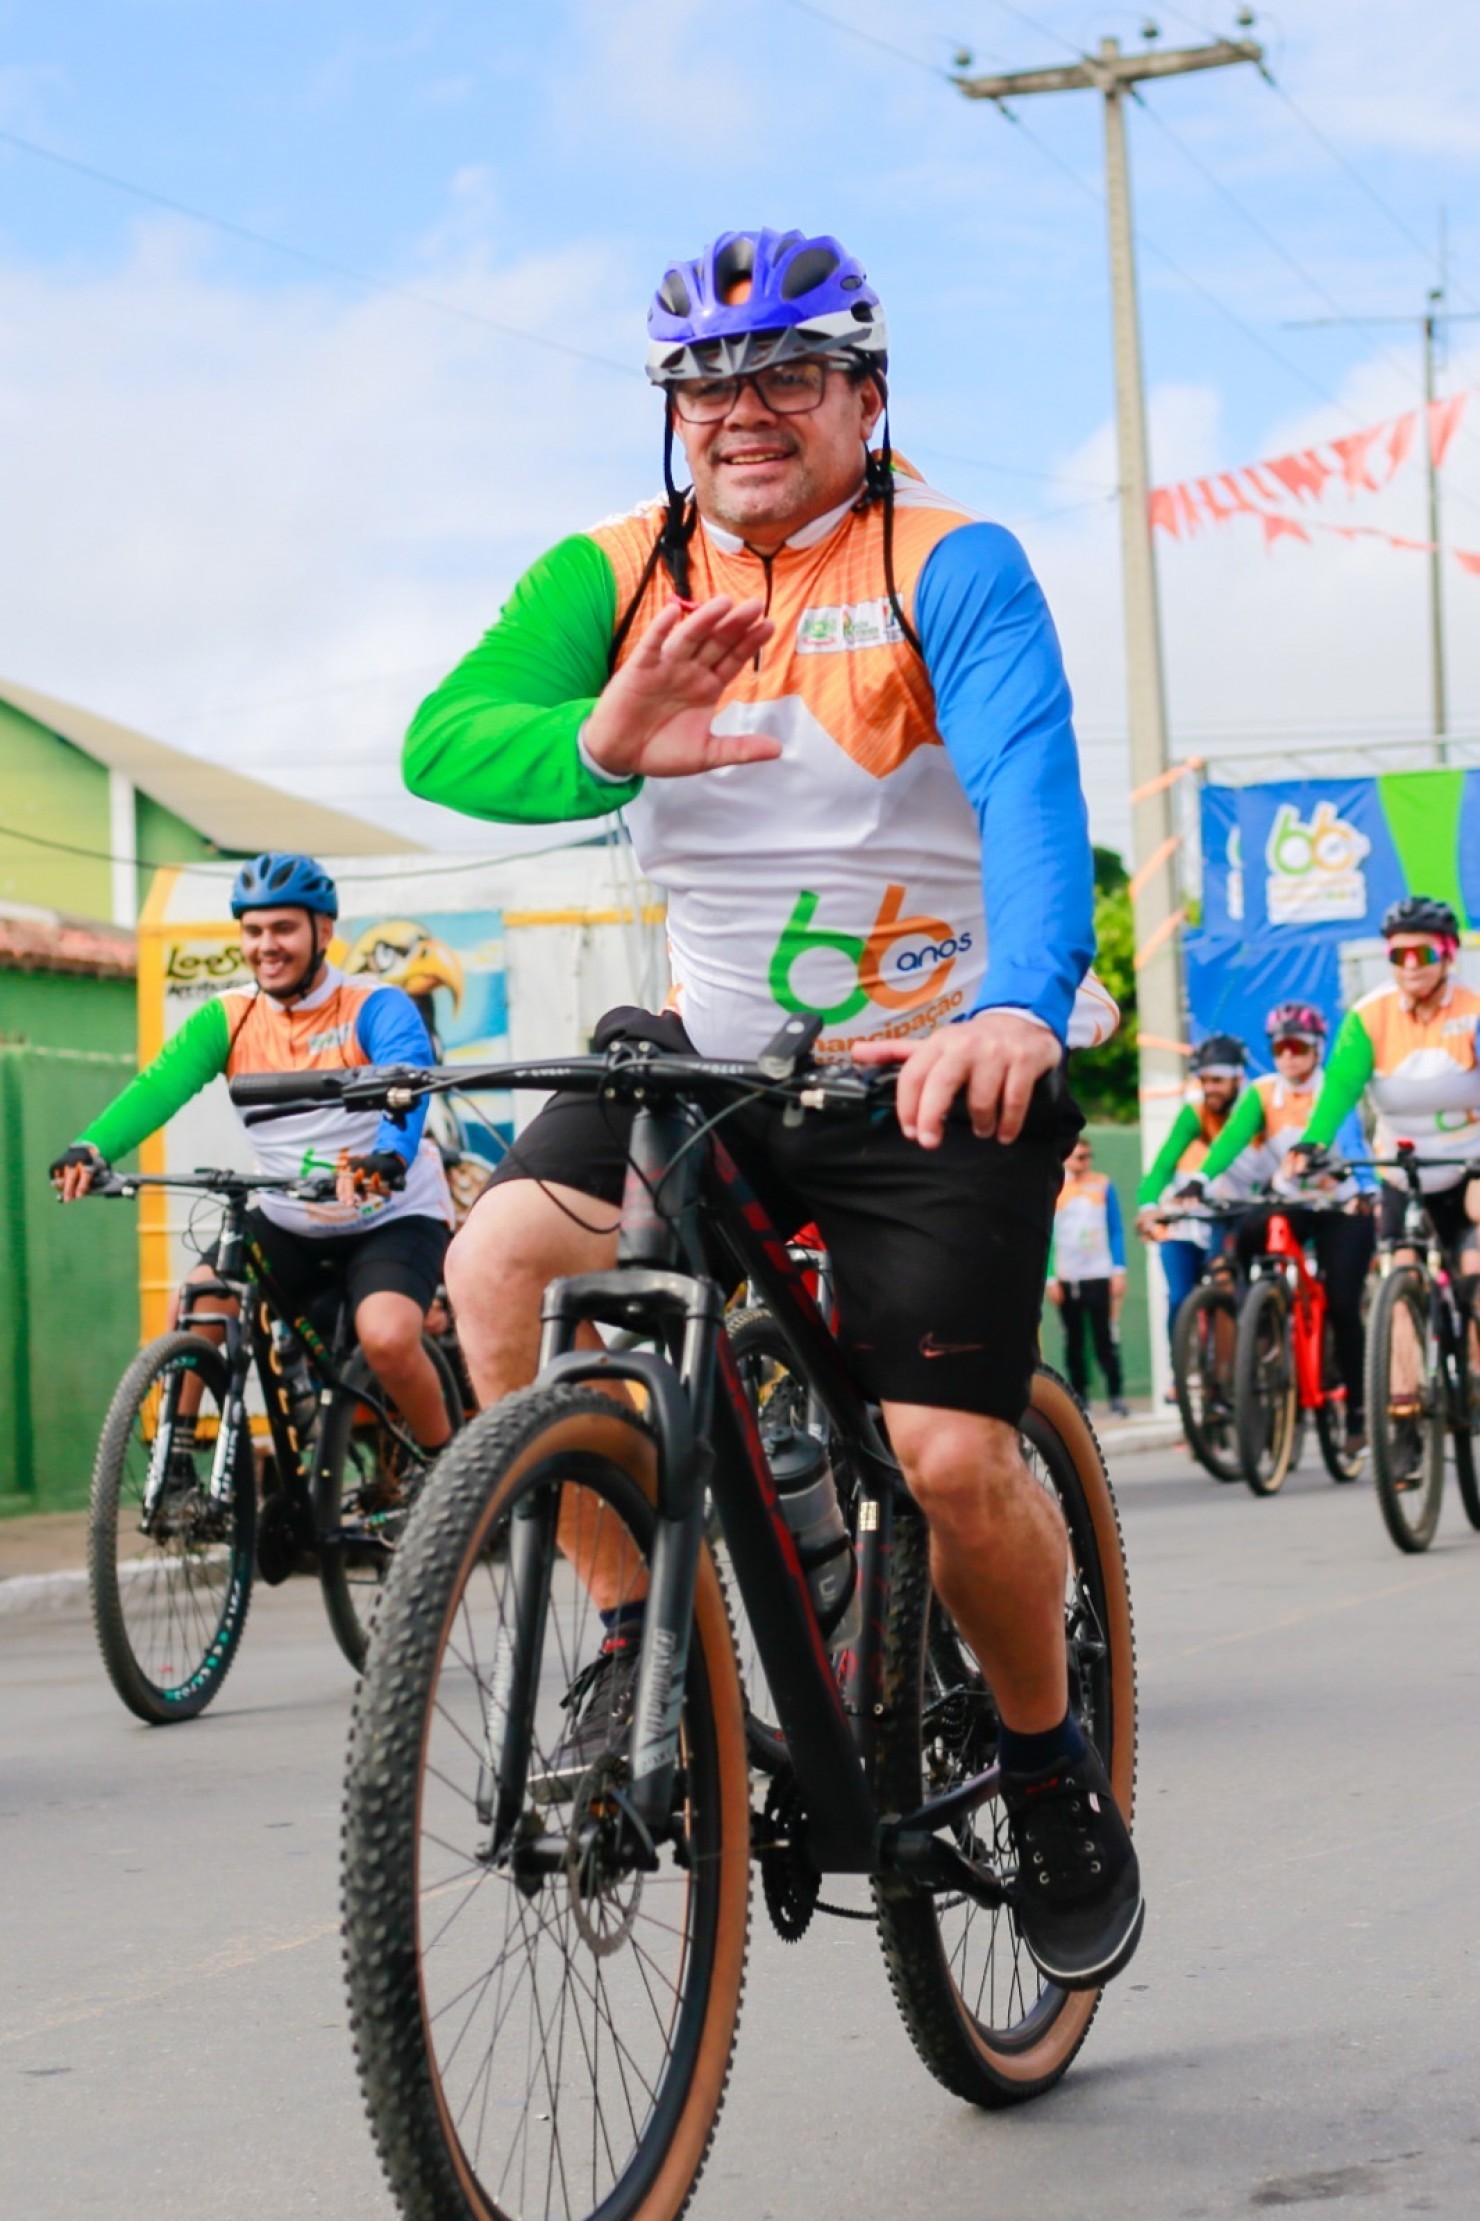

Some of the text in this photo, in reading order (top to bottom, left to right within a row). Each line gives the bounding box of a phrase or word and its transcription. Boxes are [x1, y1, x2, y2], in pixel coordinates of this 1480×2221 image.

[1268, 802, 1360, 877] 66
[768, 884, 956, 1025] 66
[896, 932, 972, 971] anos
